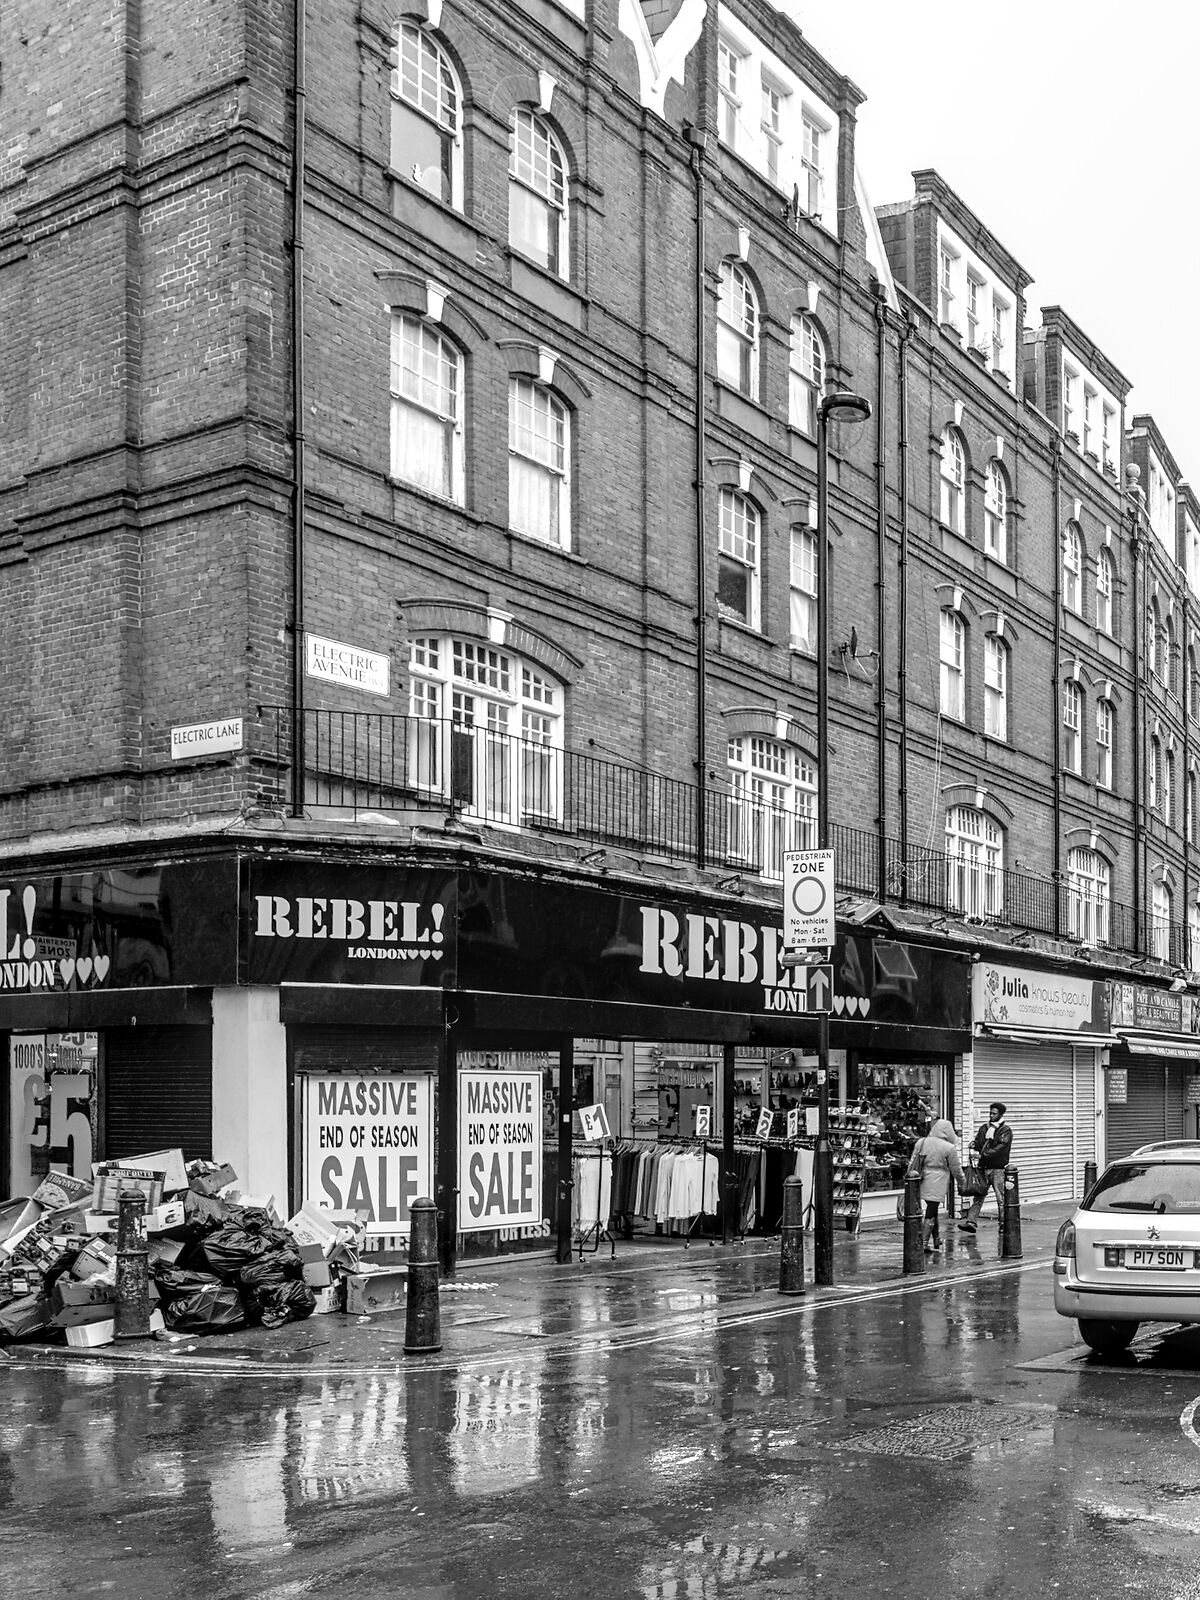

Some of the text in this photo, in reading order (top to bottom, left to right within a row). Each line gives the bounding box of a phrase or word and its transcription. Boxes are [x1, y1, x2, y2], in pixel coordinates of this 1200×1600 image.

[313, 643, 378, 672] ELECTRIC
[313, 658, 367, 683] AVENUE
[174, 723, 240, 744] ELECTRIC LANE
[786, 852, 832, 861] PEDESTRIAN
[793, 862, 825, 873] ZONE
[254, 895, 445, 944] REBEL!
[802, 917, 829, 925] vehicles
[347, 947, 407, 960] LONDON
[0, 960, 57, 989] NDON
[1002, 976, 1091, 1011] Julia knows beauty
[14, 1044, 43, 1069] 1000'S
[318, 1081, 417, 1116] MASSIVE
[467, 1082, 532, 1114] MASSIVE
[584, 1105, 609, 1137] £1
[319, 1125, 418, 1148] END OF SEASON
[468, 1123, 533, 1145] END OF SEASON
[320, 1155, 418, 1222] SALE
[468, 1151, 533, 1218] SALE
[1133, 1251, 1184, 1265] P17 SON
